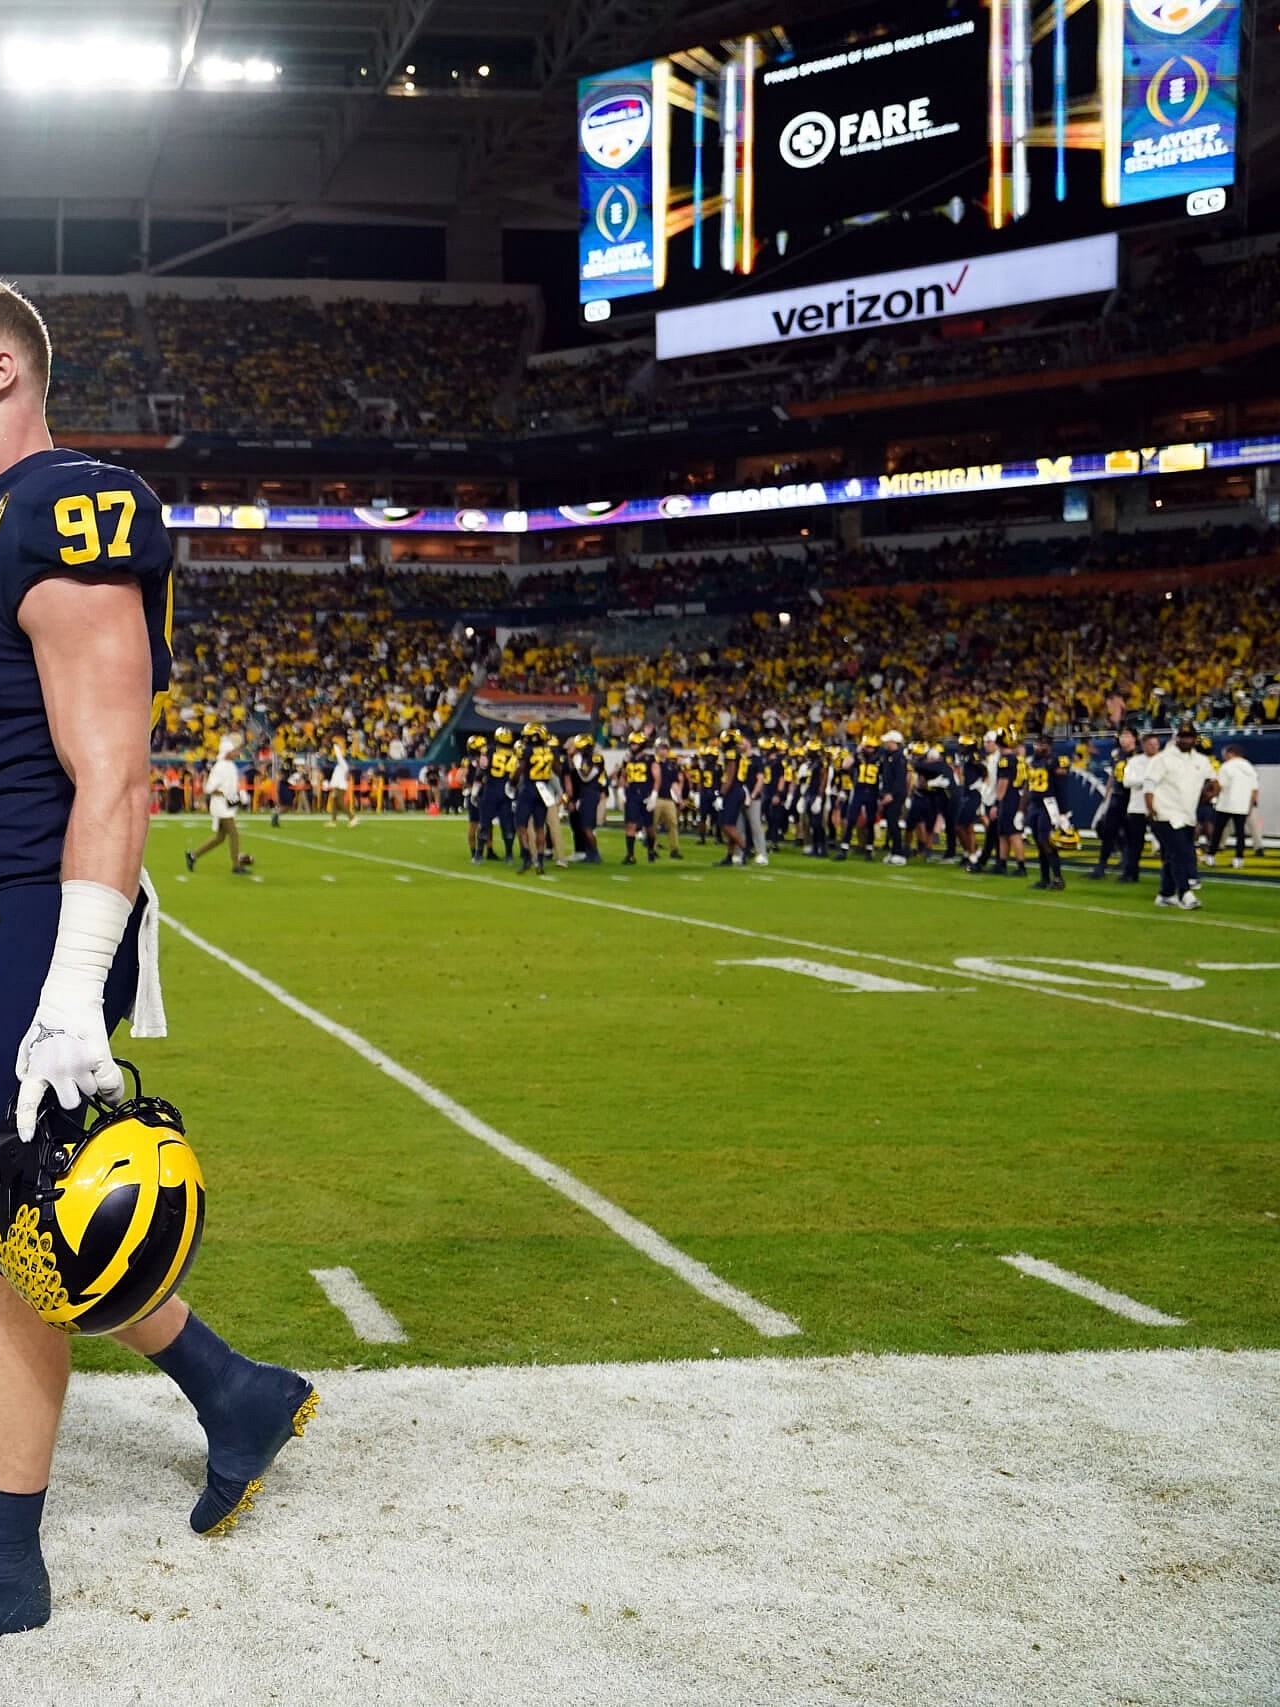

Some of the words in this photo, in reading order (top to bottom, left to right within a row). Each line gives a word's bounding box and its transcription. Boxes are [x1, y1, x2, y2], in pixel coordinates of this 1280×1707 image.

[799, 54, 847, 77] SPONSOR
[847, 49, 862, 64] OF
[863, 42, 893, 61] HARD
[894, 33, 924, 52] ROCK
[925, 20, 975, 44] STADIUM
[840, 96, 931, 147] FARE
[1133, 123, 1220, 157] PLAYOFF
[1124, 138, 1229, 174] SEMIFINAL
[1192, 193, 1220, 211] CC
[773, 281, 945, 335] verizon
[709, 482, 826, 512] GEORGIA
[878, 464, 1003, 498] MICHIGAN
[53, 490, 137, 566] 97
[490, 751, 518, 778] 54
[858, 762, 880, 786] 15
